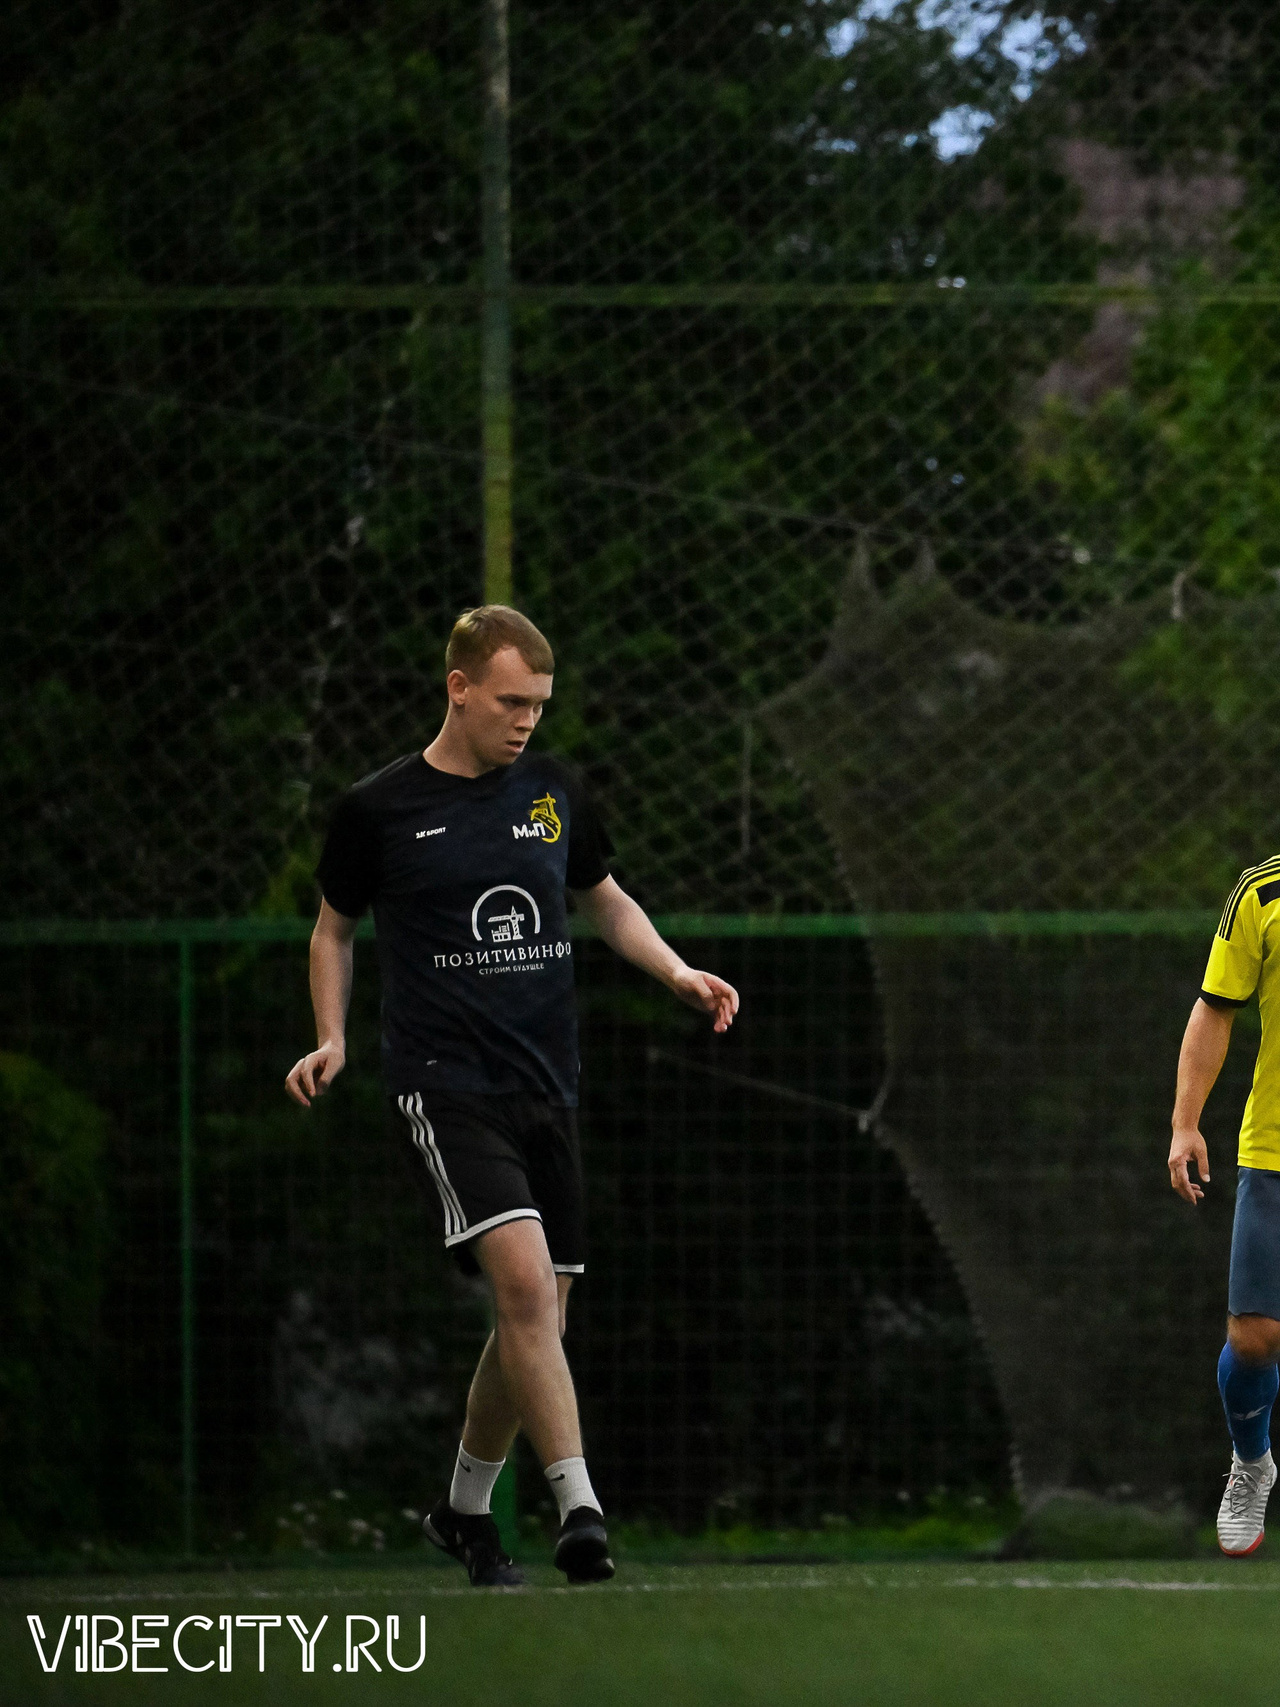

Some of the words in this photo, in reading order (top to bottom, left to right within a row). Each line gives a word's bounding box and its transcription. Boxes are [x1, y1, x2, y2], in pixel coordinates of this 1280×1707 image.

[427, 826, 446, 836] SPORT
[512, 822, 546, 839] МиП
[433, 941, 572, 968] ПОЗИТИВИНФО
[478, 966, 511, 975] СТРОИМ
